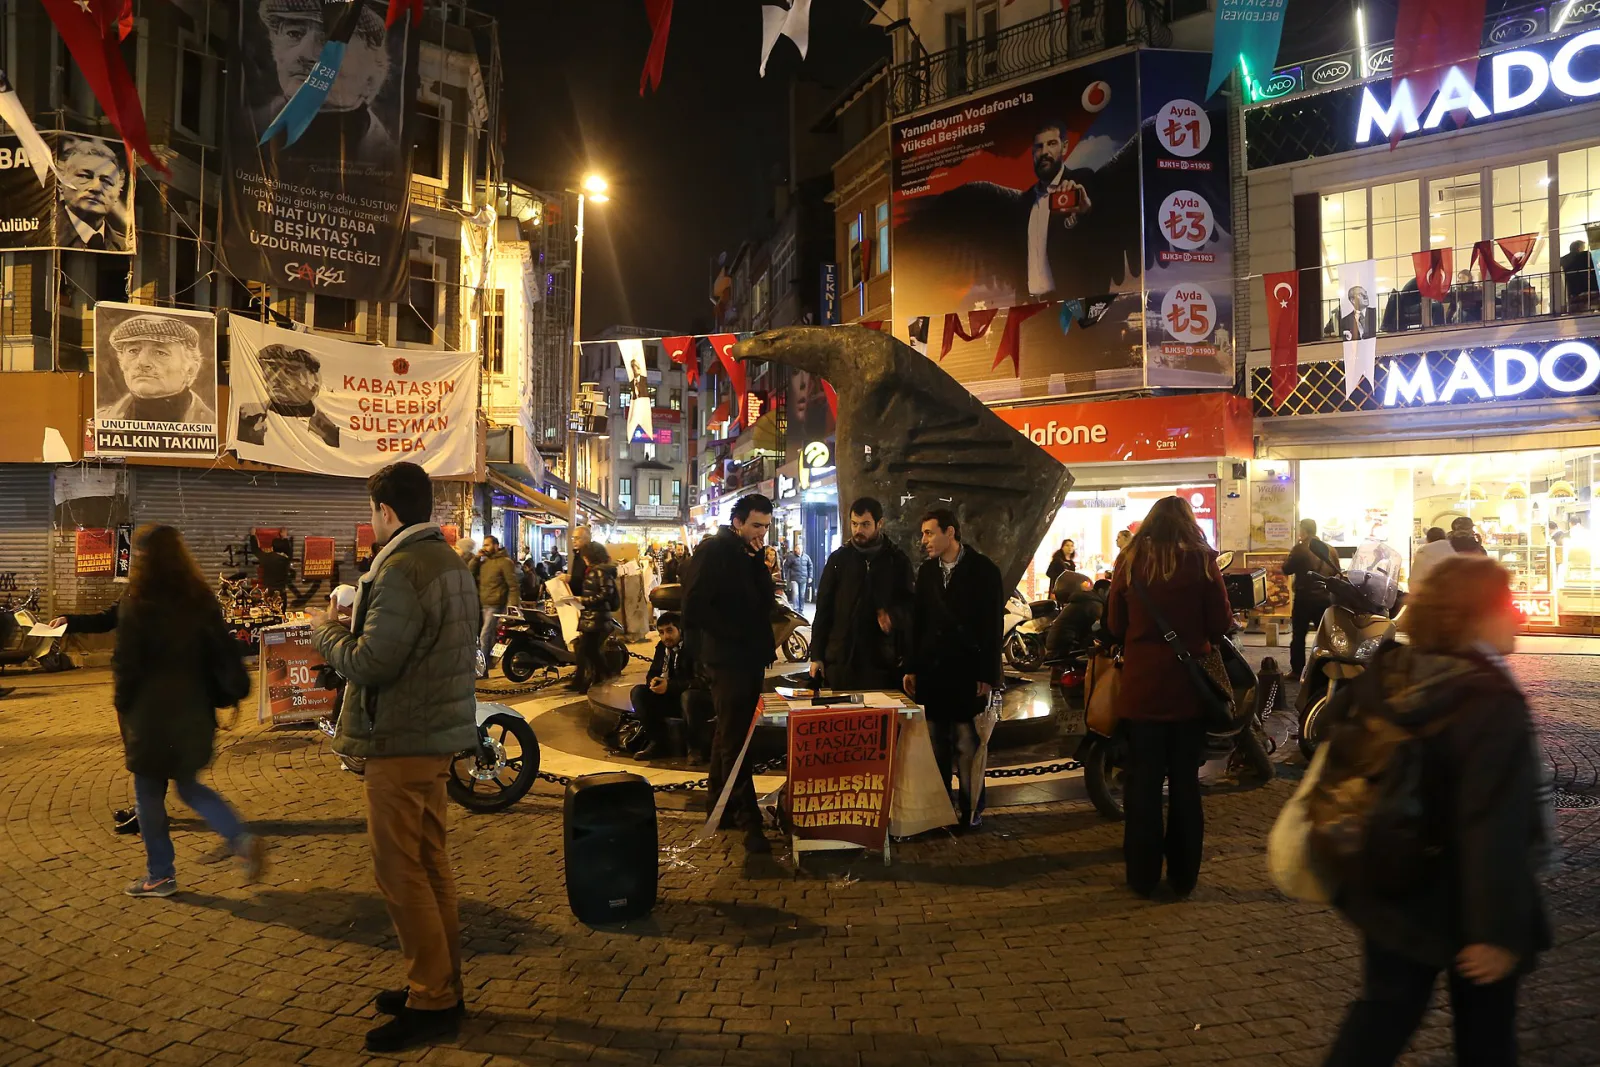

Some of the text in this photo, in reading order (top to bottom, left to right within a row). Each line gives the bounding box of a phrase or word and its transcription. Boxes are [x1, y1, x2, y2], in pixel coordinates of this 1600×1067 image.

[1316, 66, 1346, 80] MADO
[900, 93, 1034, 138] Yanındayım Vodafone'la
[1170, 106, 1196, 118] Ayda
[900, 122, 986, 153] Yüksel Beşiktaş
[300, 187, 318, 196] çok
[320, 190, 334, 201] şey
[360, 198, 398, 212] SUSTUK!
[902, 184, 931, 196] Vodafone
[275, 193, 292, 204] bizi
[294, 198, 326, 211] gidişin
[328, 203, 352, 216] kadar
[1173, 197, 1200, 209] Ayda
[0, 218, 40, 232] ulübü
[257, 200, 376, 235] RAHAT UYU BABA
[274, 220, 358, 248] BEŞİKTAŞ'ı
[250, 230, 381, 266] ÜZDÜRMEYECEĞİZ!
[1176, 290, 1202, 302] Ayda
[1384, 342, 1600, 406] MADO
[344, 375, 454, 400] KABATAŞ'IN
[358, 396, 442, 414] ÇELEBİSİ
[102, 420, 212, 432] UNUTULMAYACAKSIN
[350, 414, 448, 434] SÜLEYMAN
[100, 434, 214, 450] HALKIN TAKIMI
[376, 438, 426, 452] SEBA
[78, 552, 112, 560] BİRLEŞİK
[300, 630, 314, 638] Şan
[290, 666, 310, 685] 50
[292, 696, 307, 706] 286
[796, 715, 878, 736] GERİCİLİĞİ
[796, 730, 878, 752] VE FAŞİZMİ
[795, 746, 877, 768] YENECEĞİZ
[793, 772, 884, 796] BİRLEŞİK
[792, 792, 884, 813] HAZİRAN
[792, 810, 880, 828] HAREKETİ
